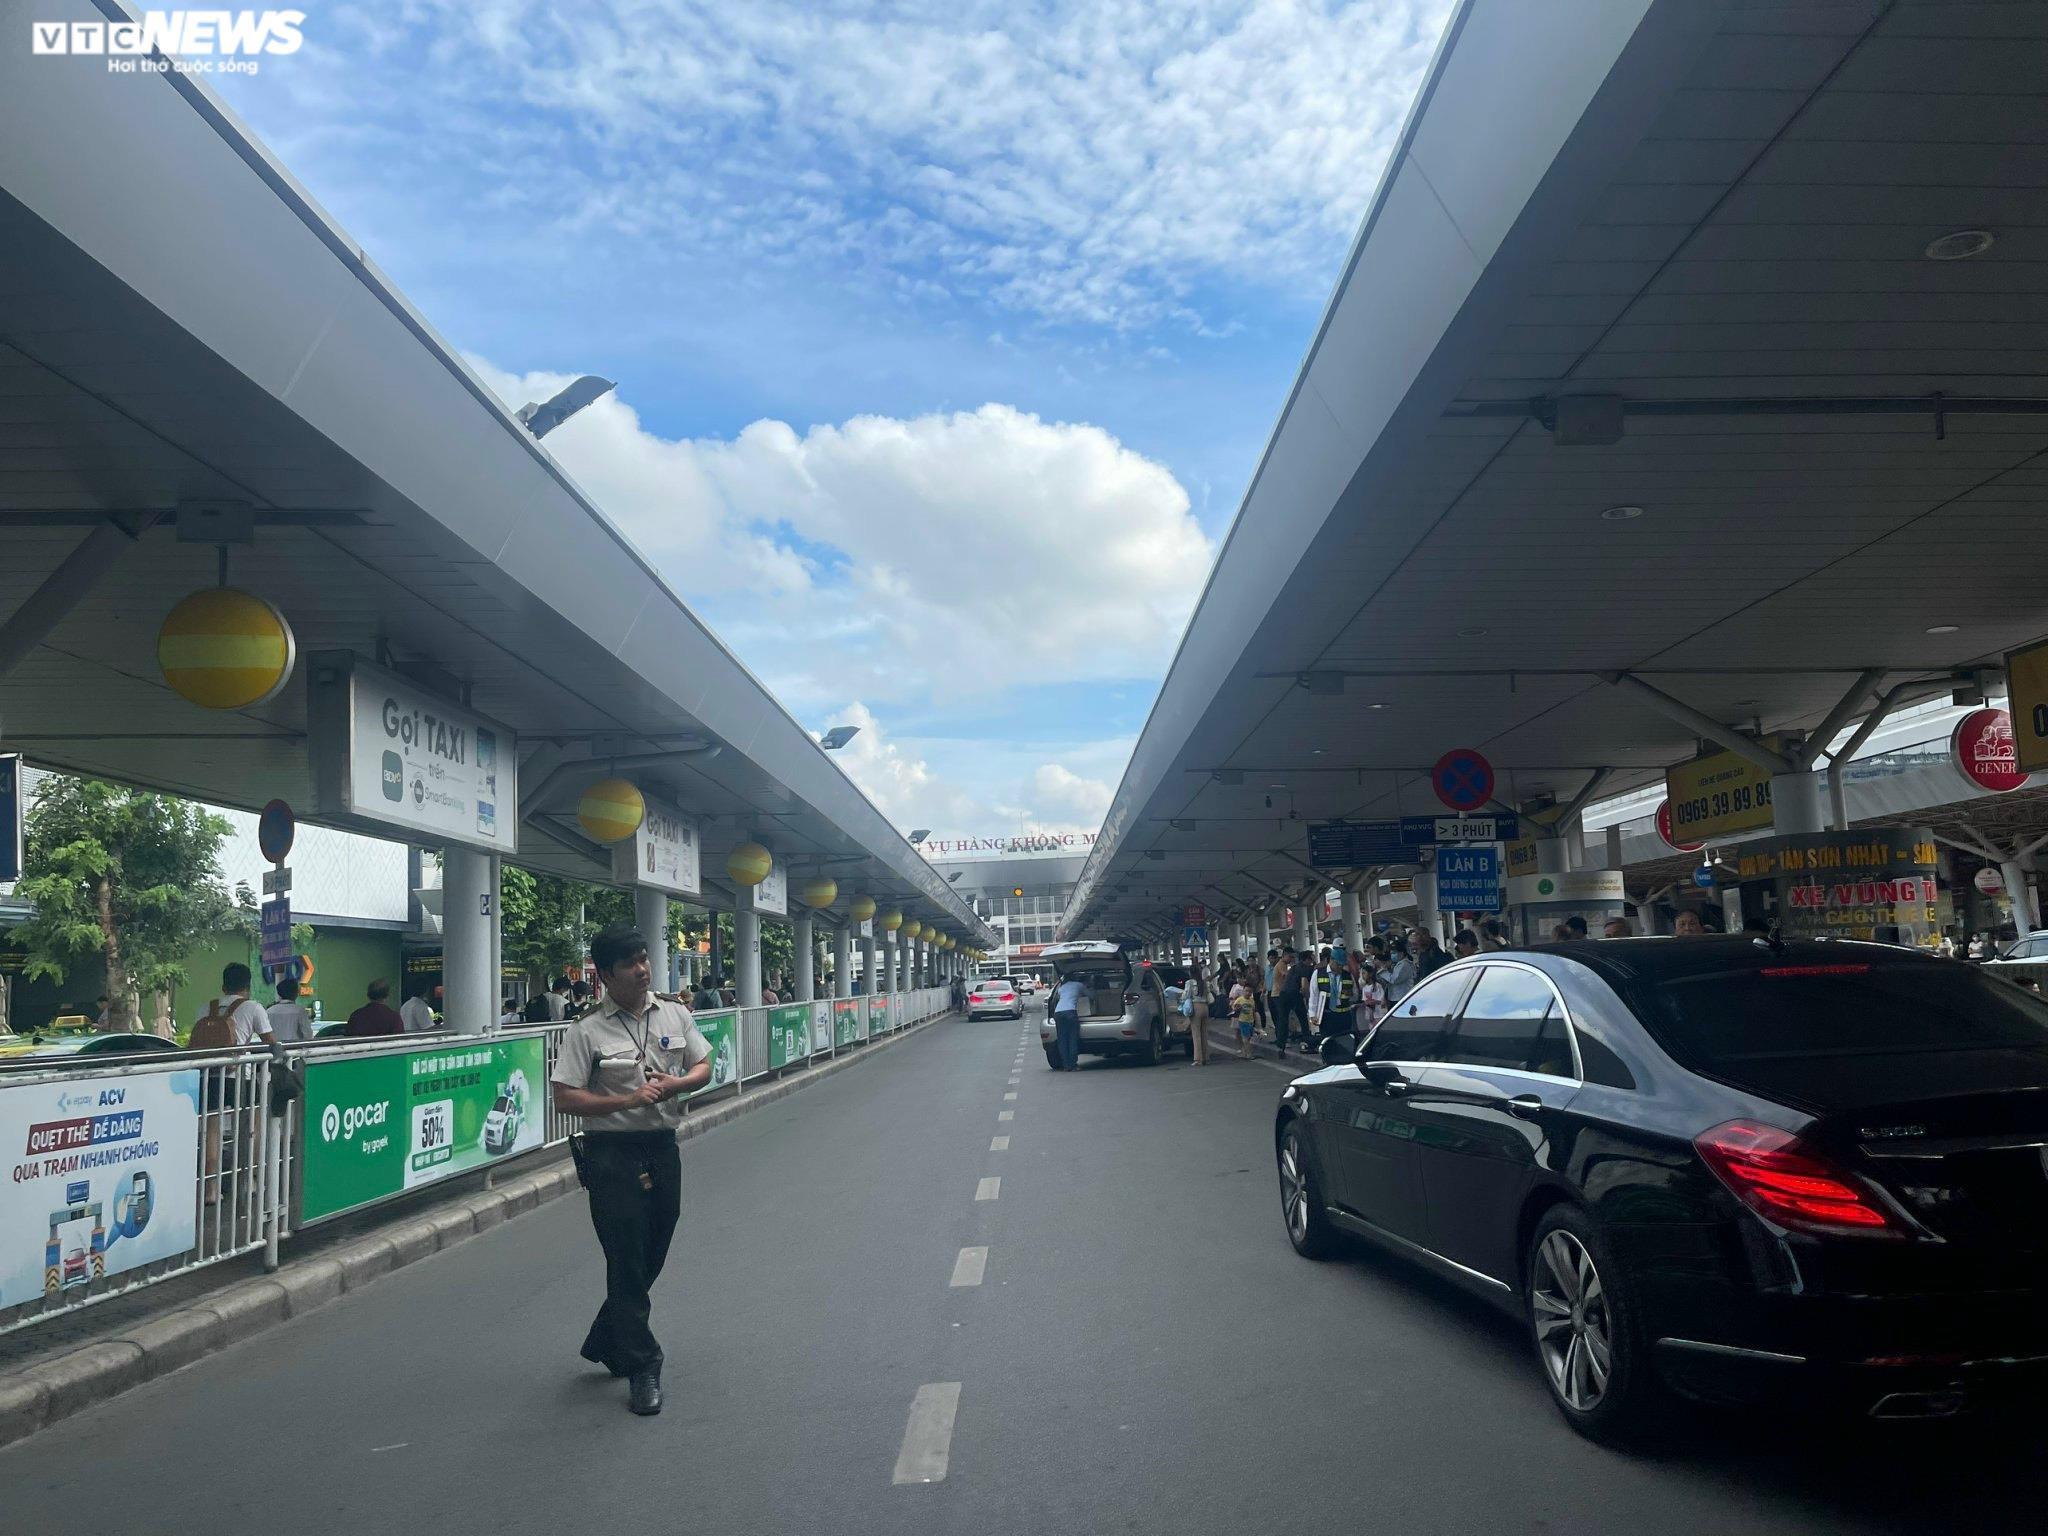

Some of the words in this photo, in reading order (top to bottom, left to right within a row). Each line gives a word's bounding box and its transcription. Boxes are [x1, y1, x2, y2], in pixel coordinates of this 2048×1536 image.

[382, 698, 419, 756] Gọi
[424, 714, 465, 765] TAXI
[927, 841, 951, 854] VỤ
[956, 835, 1005, 852] HÀNG
[1010, 832, 1074, 849] KHÔNG
[1452, 825, 1459, 837] 3
[1462, 822, 1492, 837] PHÚT
[1479, 857, 1489, 871] B
[1791, 885, 1825, 908] XE
[1834, 876, 1916, 905] VŨNG
[99, 1088, 126, 1106] ACV
[31, 1128, 62, 1151] QUẸT
[66, 1119, 90, 1144] THẺ
[110, 1115, 141, 1136] DÀNG
[343, 1100, 390, 1140] gocar
[421, 1116, 444, 1148] 50%
[362, 1140, 372, 1154] by
[372, 1136, 389, 1153] gojek
[13, 1164, 40, 1183] QUA
[43, 1154, 79, 1177] TRẠM
[80, 1148, 121, 1170] NHANH
[122, 1140, 159, 1162] CHÓNG
